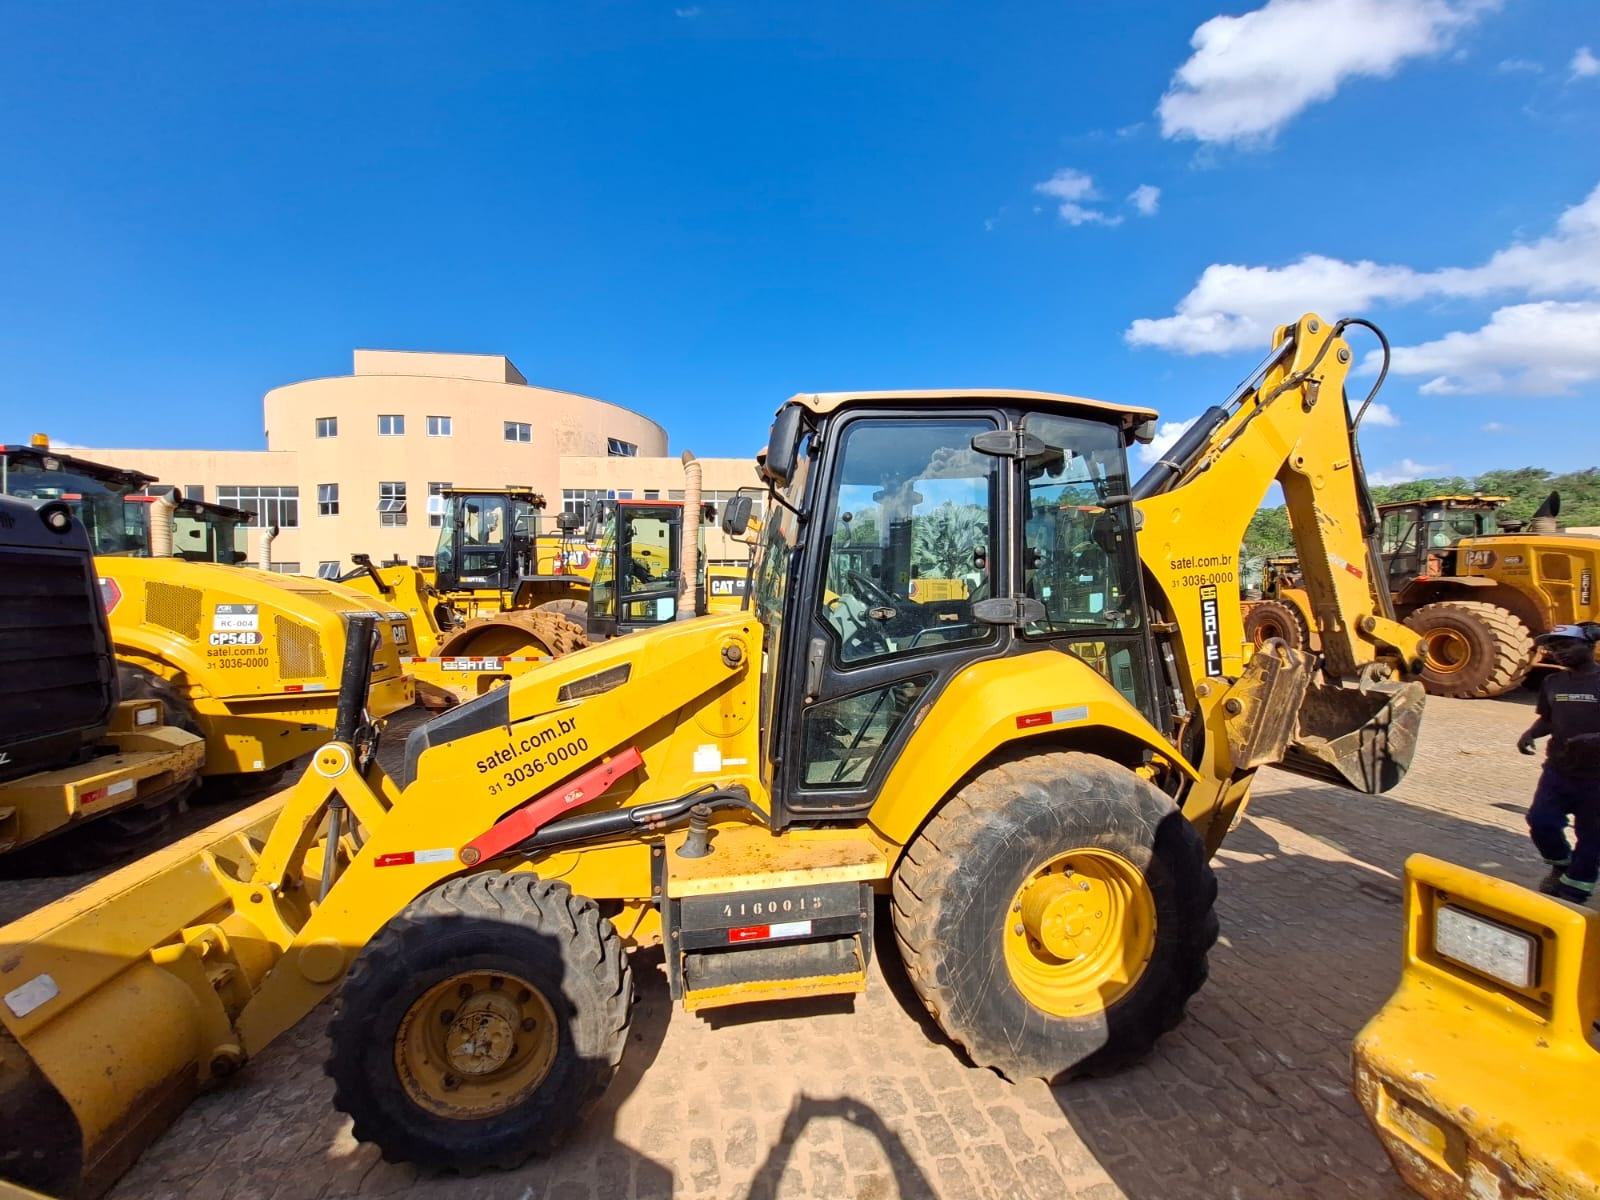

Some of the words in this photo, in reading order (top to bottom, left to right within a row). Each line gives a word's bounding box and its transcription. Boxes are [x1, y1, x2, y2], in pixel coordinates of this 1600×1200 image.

[1171, 554, 1232, 570] satel.com.br
[1466, 551, 1490, 565] CAT
[1183, 572, 1233, 587] 3036-0000
[712, 581, 733, 594] CAT
[209, 632, 256, 645] CP54B
[393, 626, 407, 643] CAT
[1203, 601, 1220, 676] SATEL
[207, 646, 268, 656] satel.com.br
[220, 658, 268, 668] 3036-0000
[458, 661, 503, 670] SATEL
[476, 717, 577, 774] satel.com.br
[488, 782, 503, 796] 31
[503, 737, 589, 787] 3036-0000
